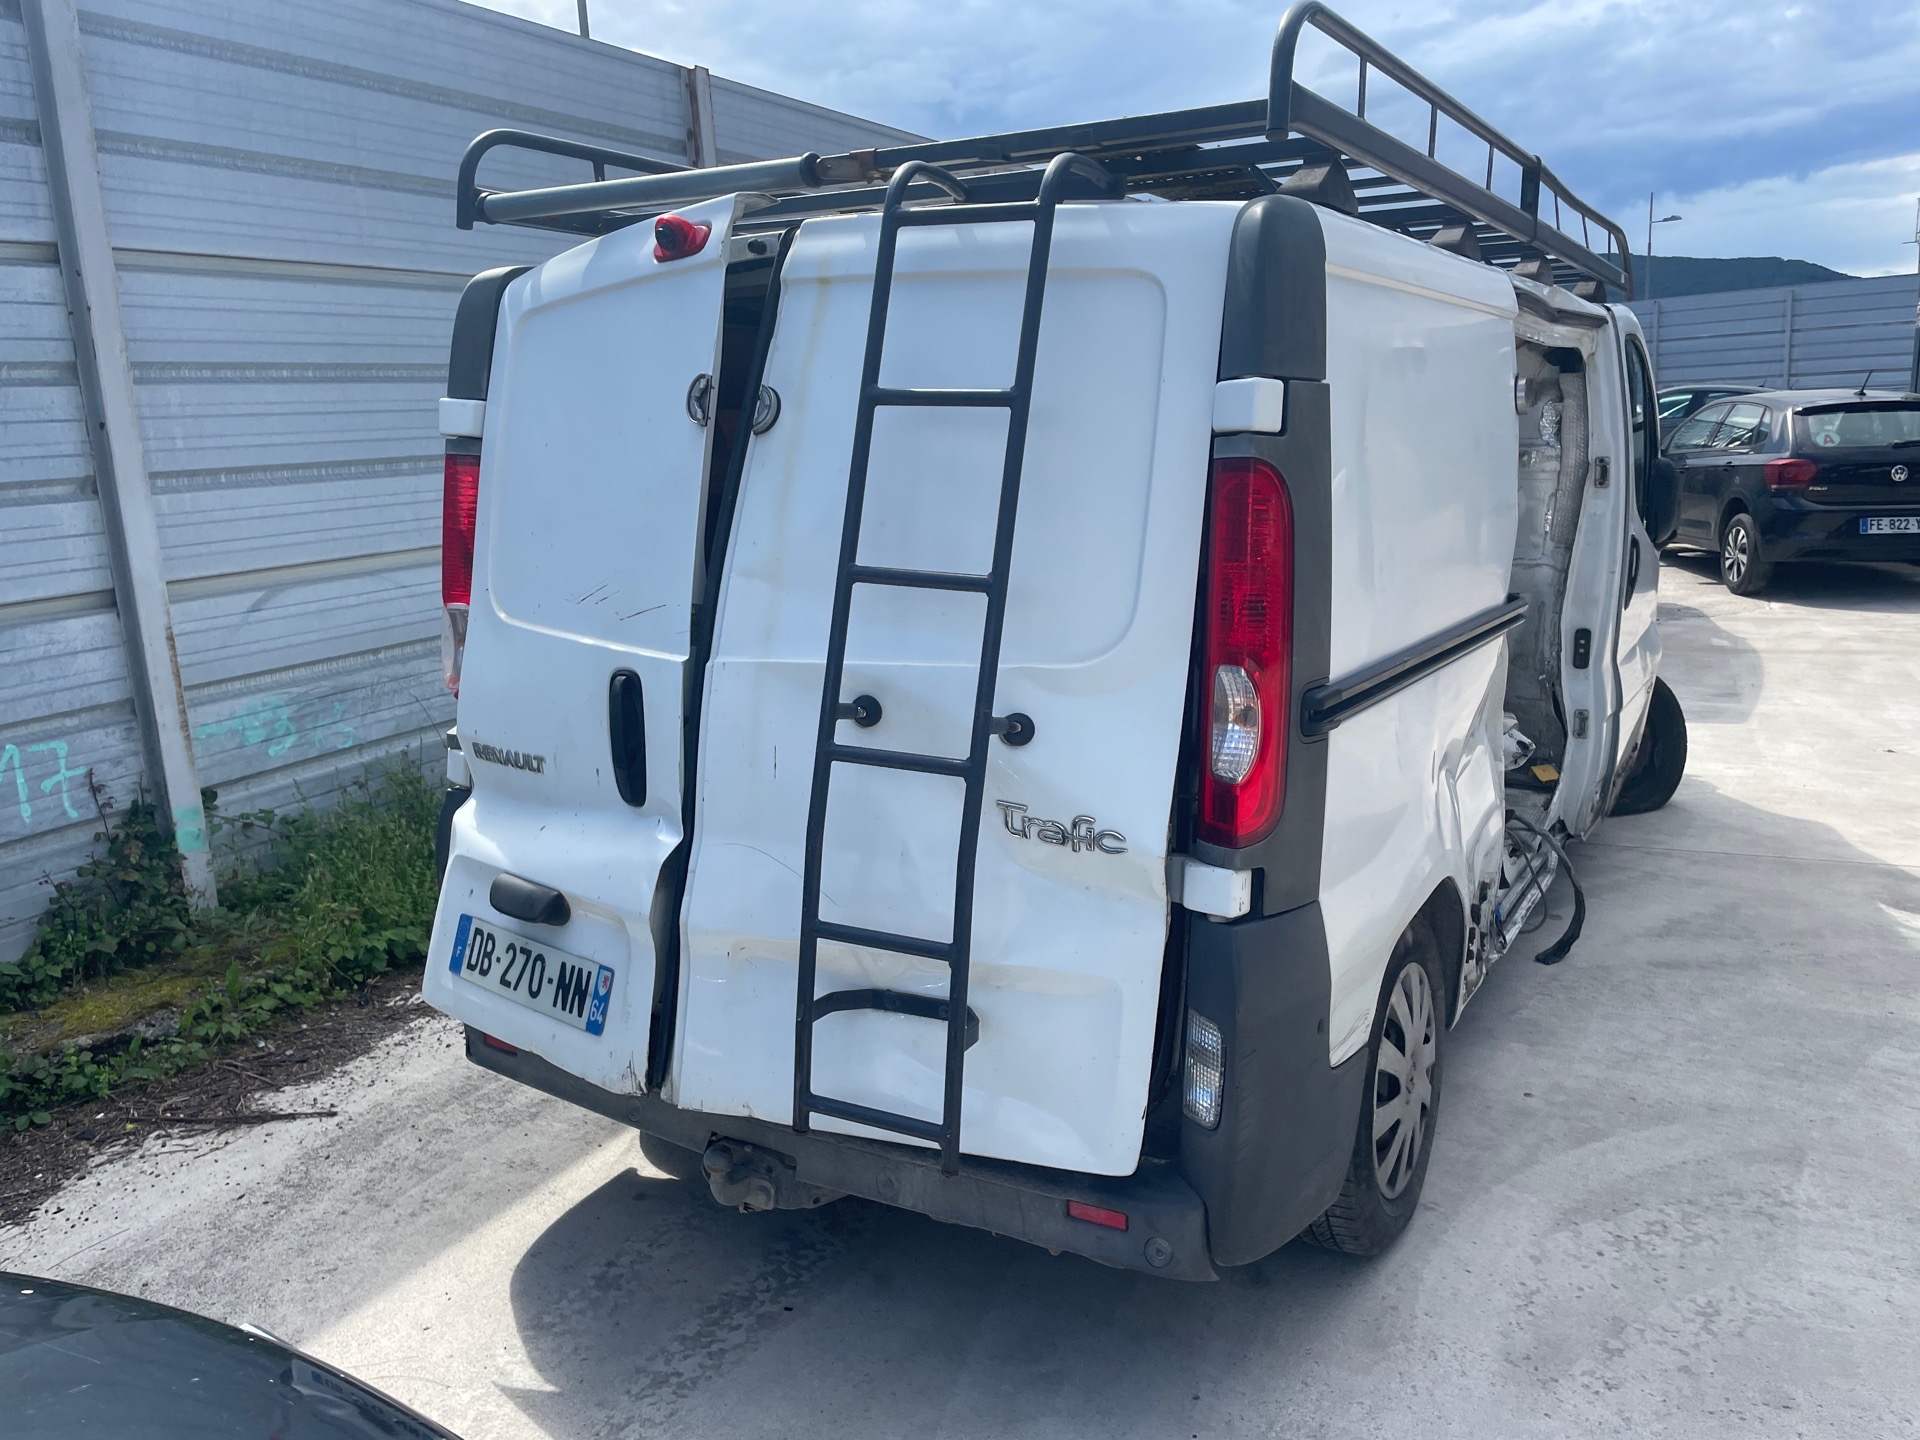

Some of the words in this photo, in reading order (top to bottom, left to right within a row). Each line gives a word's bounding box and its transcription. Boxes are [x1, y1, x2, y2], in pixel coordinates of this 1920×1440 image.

[1824, 434, 1835, 445] A
[472, 741, 546, 774] RENAULT
[996, 799, 1128, 854] Trafic
[456, 946, 462, 957] F
[466, 927, 592, 1018] DB-270-NN
[589, 999, 605, 1025] 64
